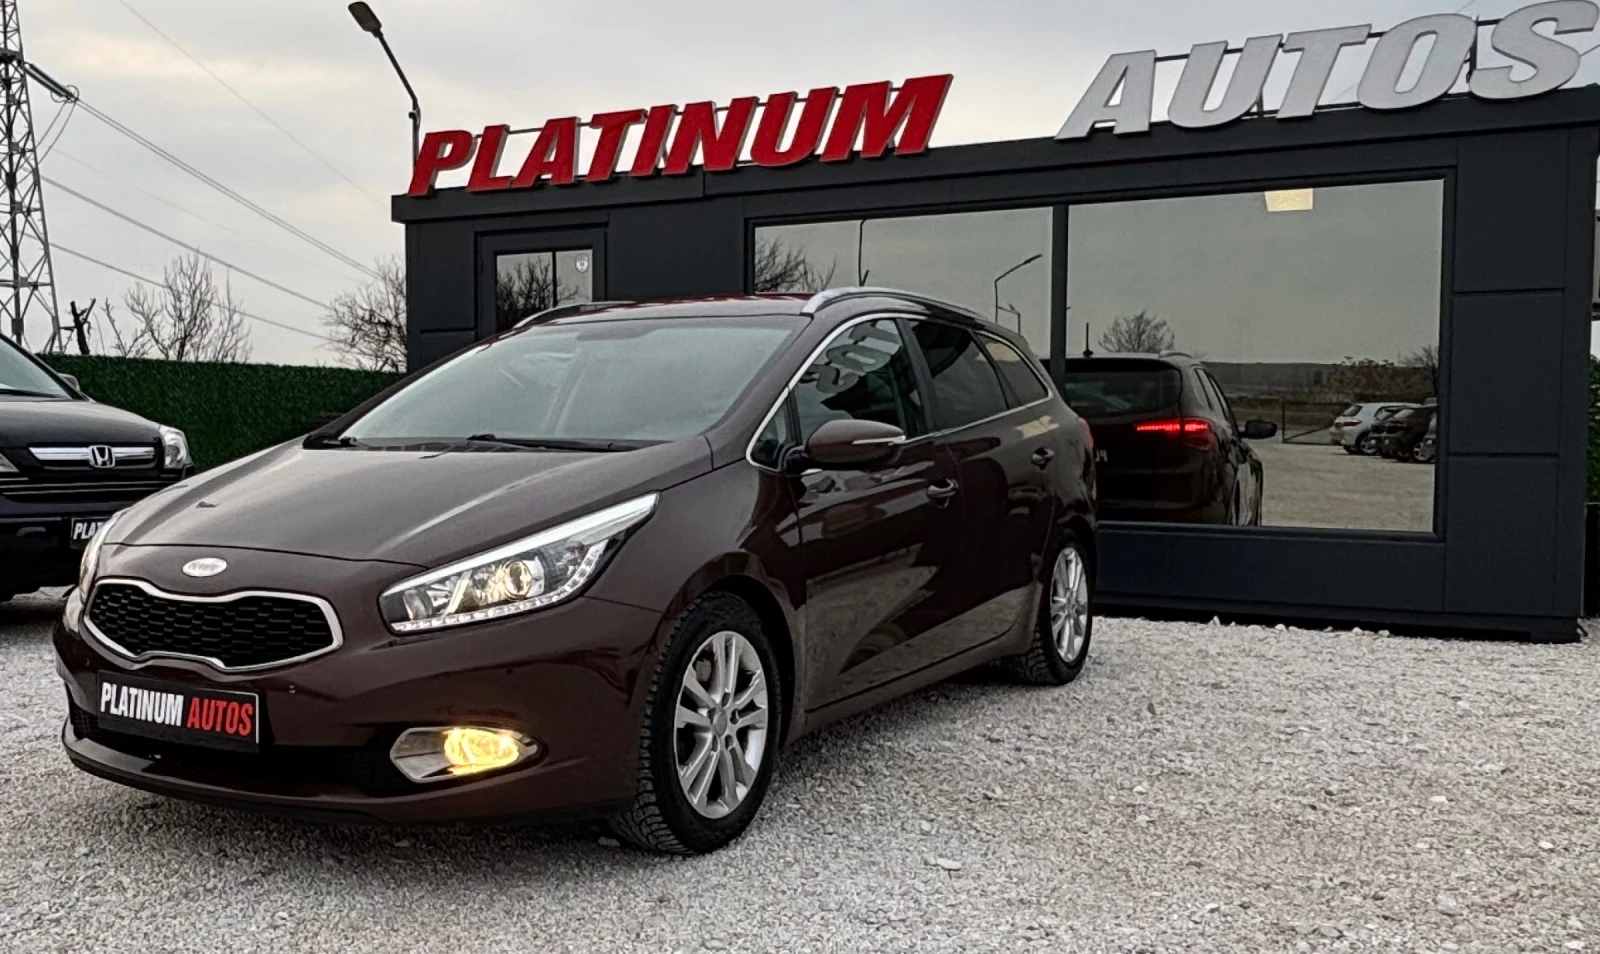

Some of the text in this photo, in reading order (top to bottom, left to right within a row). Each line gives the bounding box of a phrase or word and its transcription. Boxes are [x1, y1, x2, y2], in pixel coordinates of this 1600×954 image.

[408, 0, 1600, 196] PLATINUM AUTOS
[100, 681, 254, 737] PLATINUM AUTOS
